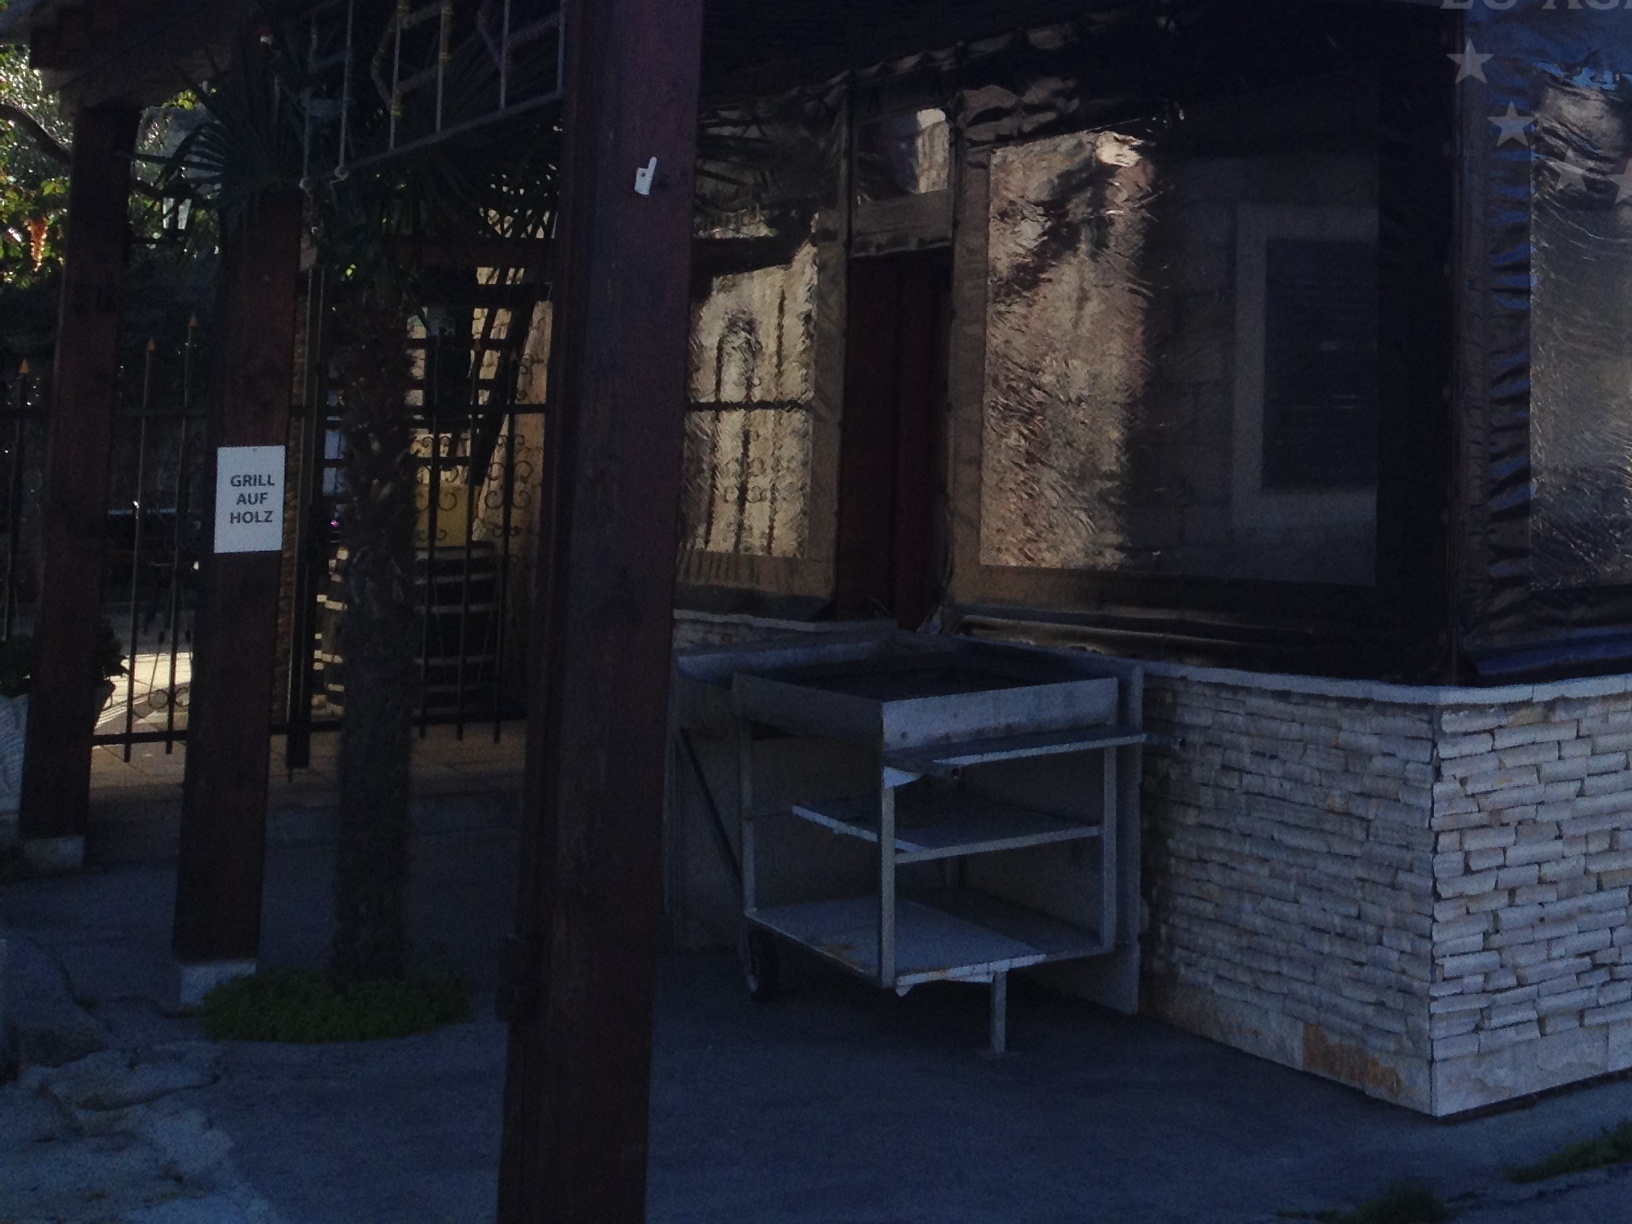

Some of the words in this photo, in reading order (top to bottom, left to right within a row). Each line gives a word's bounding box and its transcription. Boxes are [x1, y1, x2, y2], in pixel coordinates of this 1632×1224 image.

[230, 474, 275, 487] GRILL
[236, 492, 268, 505] AUF
[229, 510, 273, 524] HOLZ
